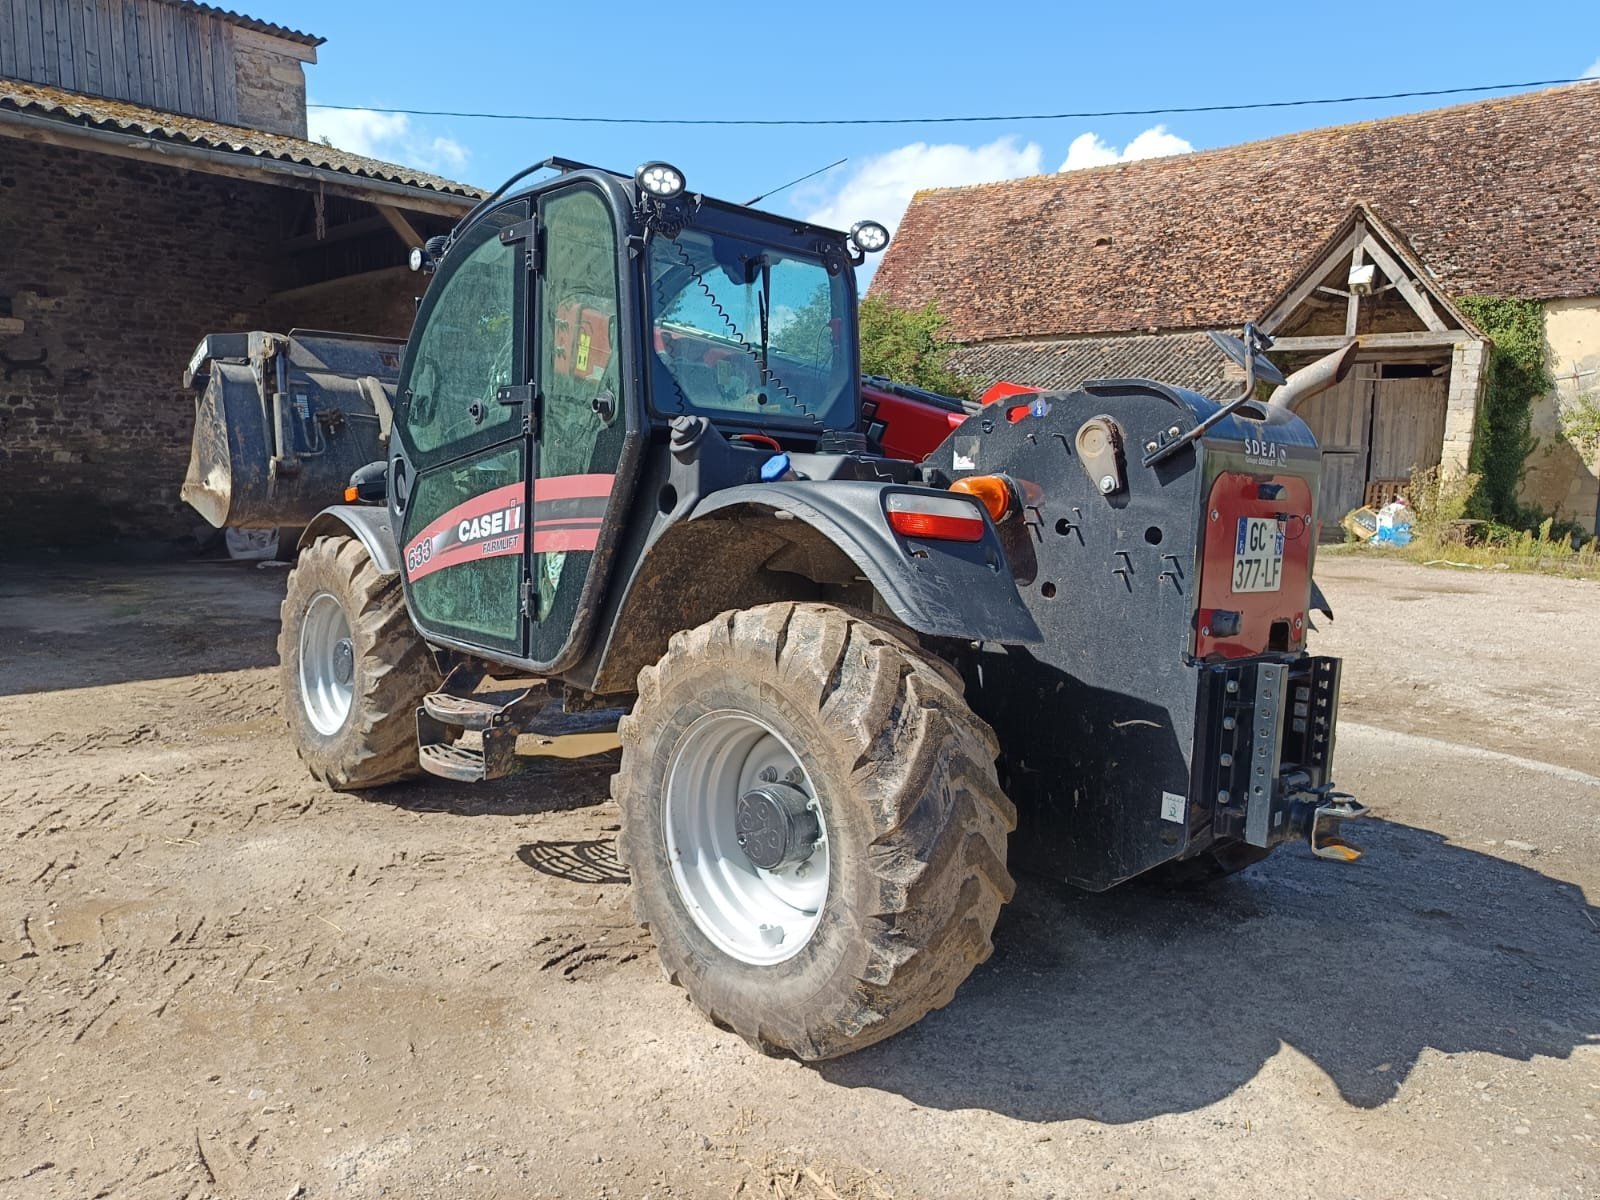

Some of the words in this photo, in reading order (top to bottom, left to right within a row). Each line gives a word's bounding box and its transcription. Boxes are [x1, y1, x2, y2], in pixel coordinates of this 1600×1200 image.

[1245, 439, 1276, 458] SDEA
[408, 537, 433, 572] 633
[483, 536, 519, 554] FARMLIFT
[1235, 558, 1281, 589] 377-LF
